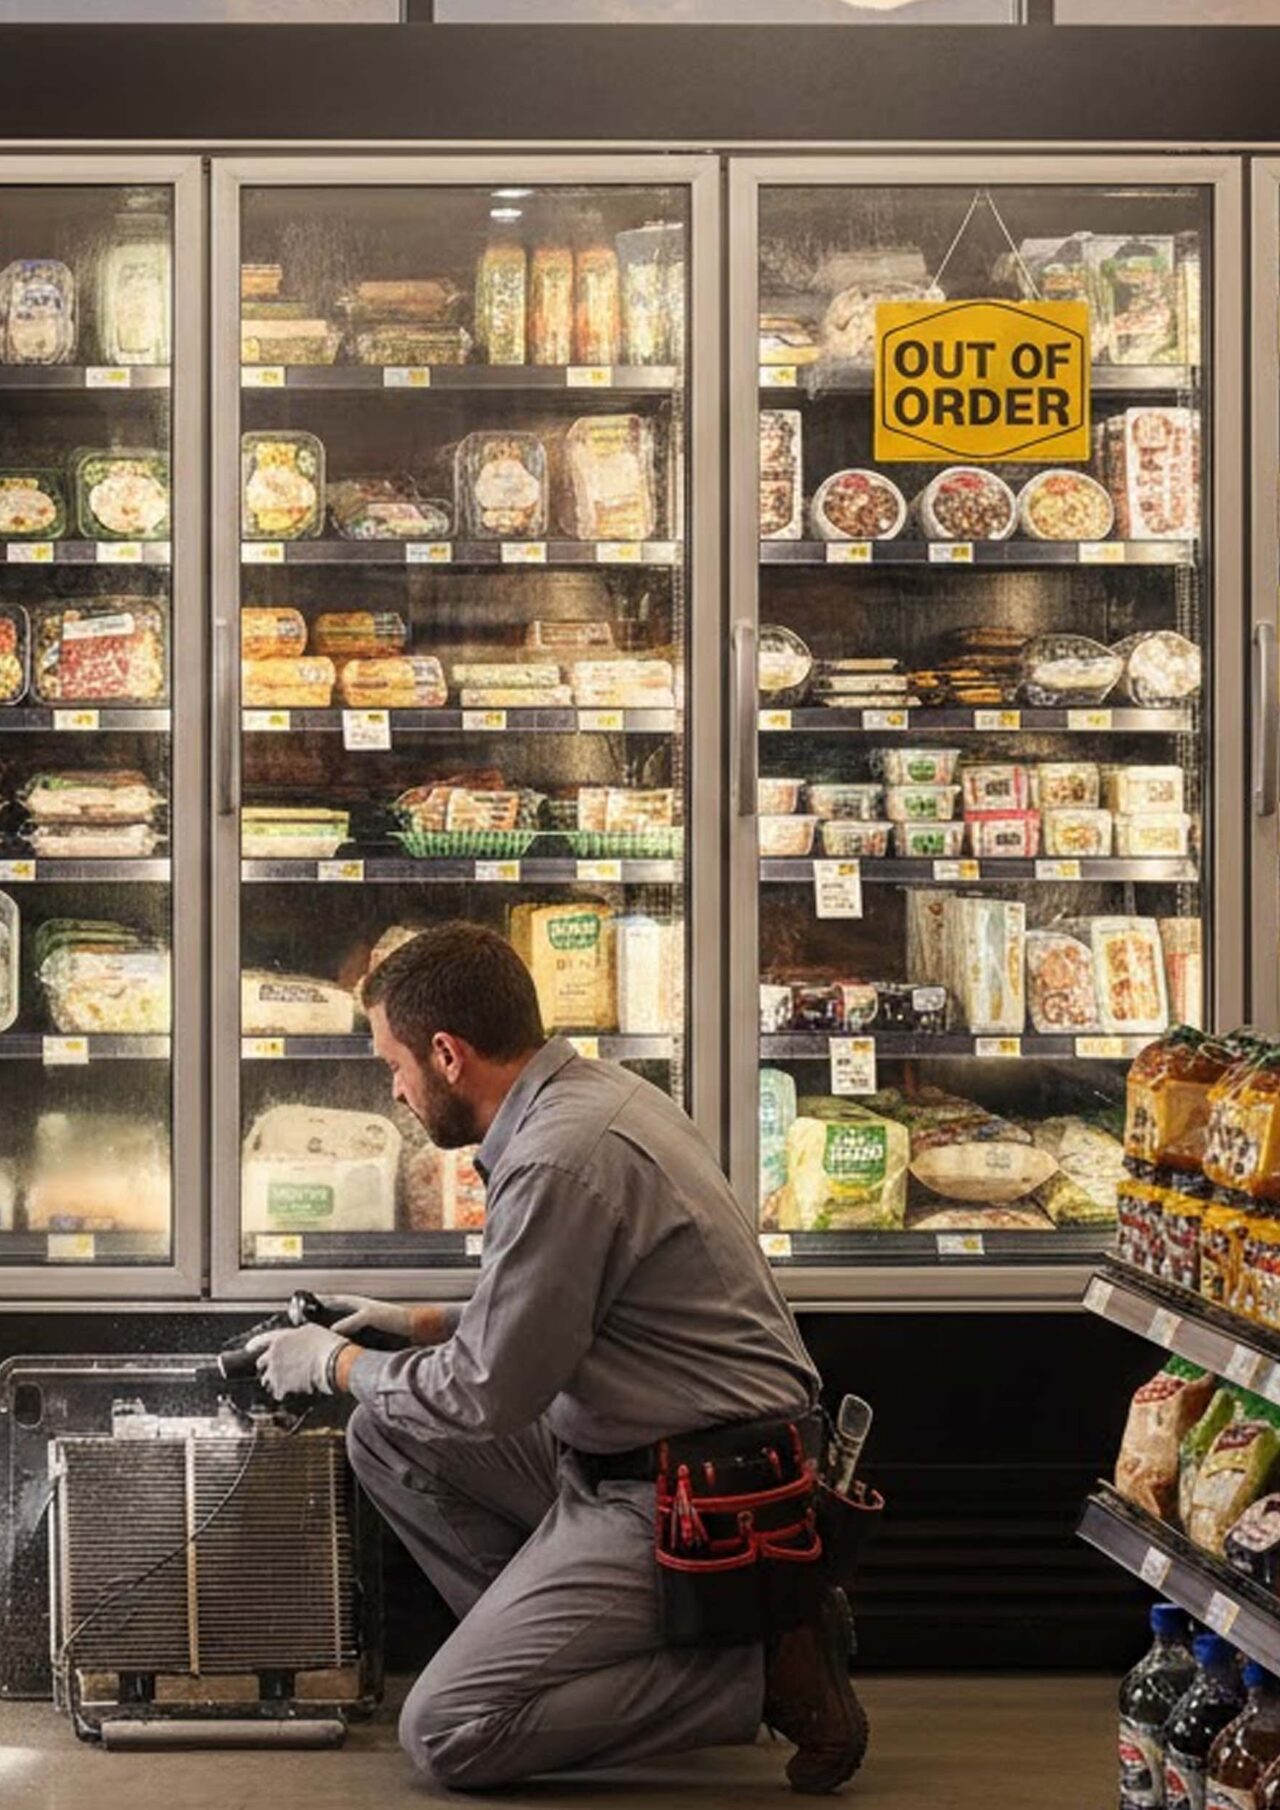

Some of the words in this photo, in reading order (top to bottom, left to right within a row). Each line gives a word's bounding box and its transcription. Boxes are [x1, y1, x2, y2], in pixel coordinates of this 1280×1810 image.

[893, 341, 996, 379] OUT
[1011, 341, 1072, 379] OF
[893, 387, 1070, 426] ORDER
